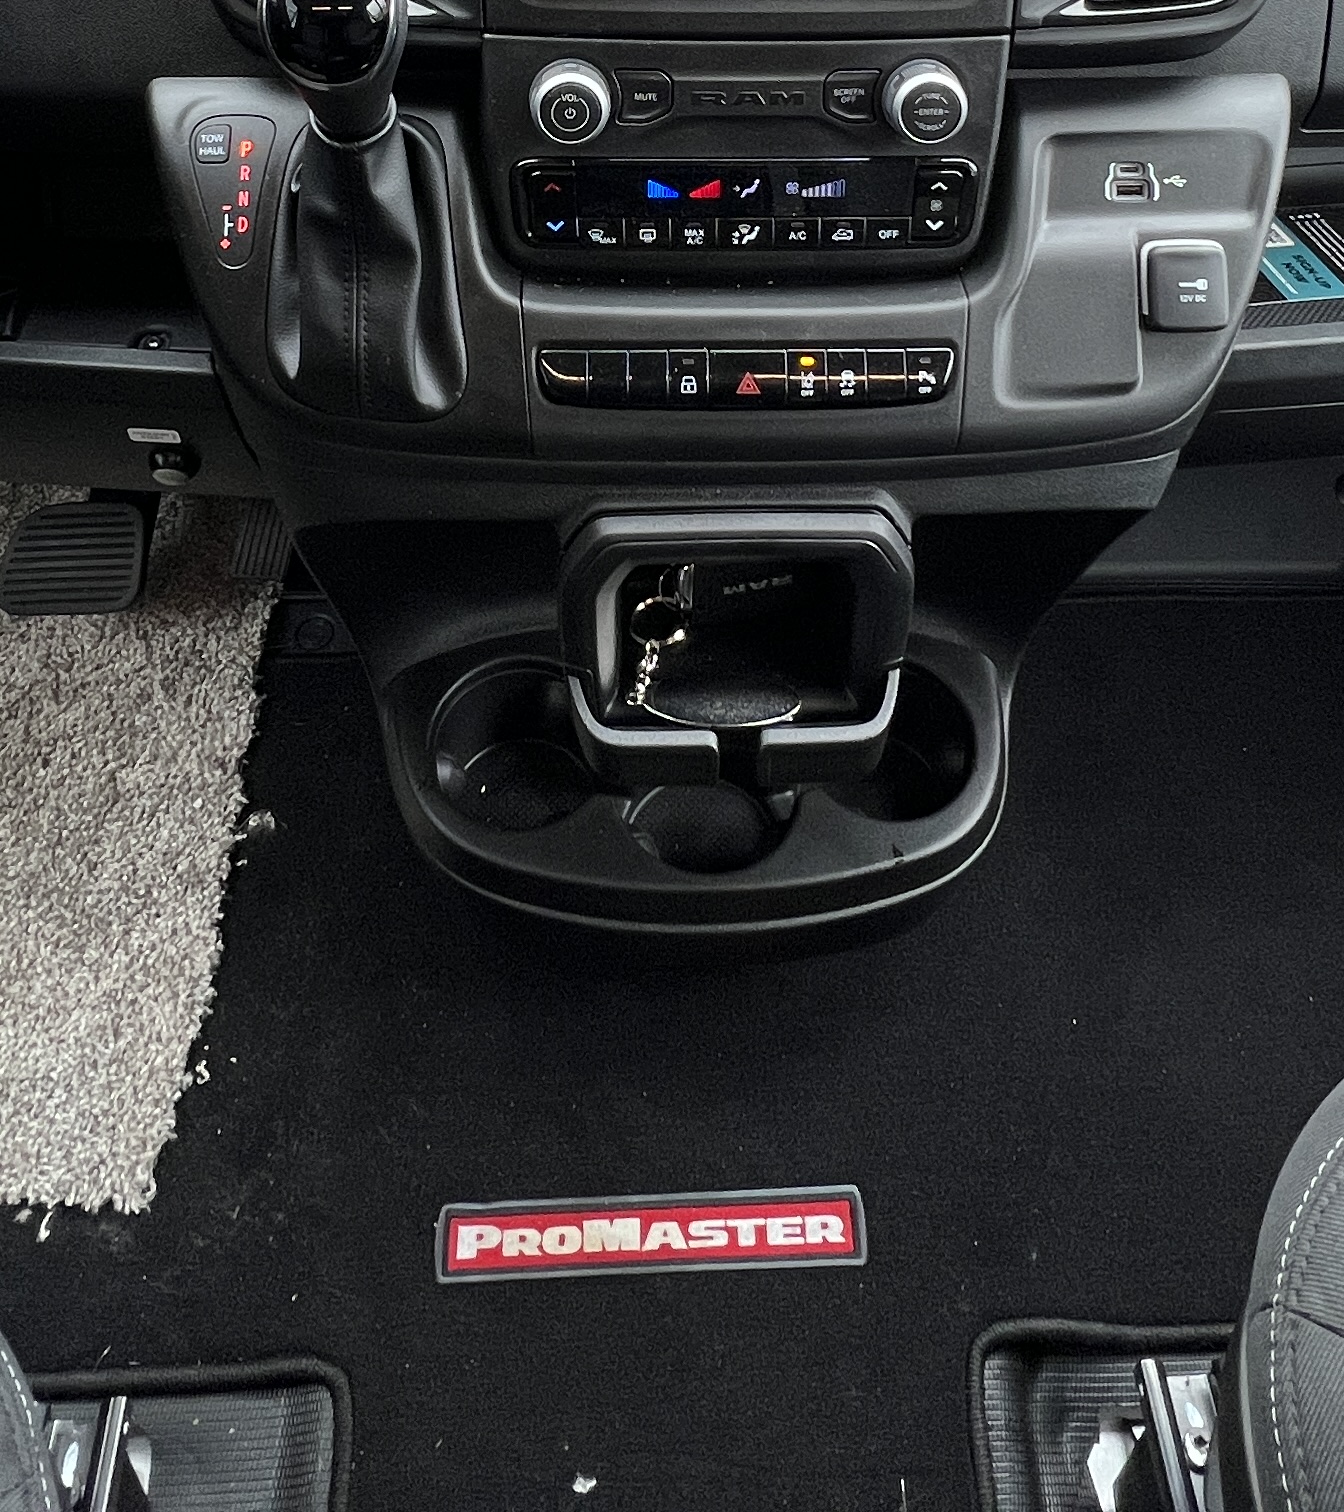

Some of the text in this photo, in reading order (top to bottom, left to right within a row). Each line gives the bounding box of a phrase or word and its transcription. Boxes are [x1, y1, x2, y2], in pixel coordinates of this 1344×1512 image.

[634, 92, 658, 102] MUTE
[833, 88, 864, 97] SCREEN
[561, 93, 579, 103] VOL
[691, 90, 805, 106] RAM
[918, 108, 944, 116] ENTER
[200, 134, 225, 143] TOW
[198, 147, 227, 156] HAUL
[239, 140, 254, 157] P
[239, 165, 252, 181] R
[237, 190, 251, 207] N
[236, 216, 249, 233] D
[684, 229, 705, 237] MAX
[788, 231, 807, 241] A/C
[878, 229, 900, 240] OFF
[599, 236, 617, 244] MAX
[686, 237, 704, 245] A/C
[1281, 262, 1310, 283] NOW
[1292, 254, 1332, 289] SIGN-UP
[1179, 294, 1207, 303] 12V DC
